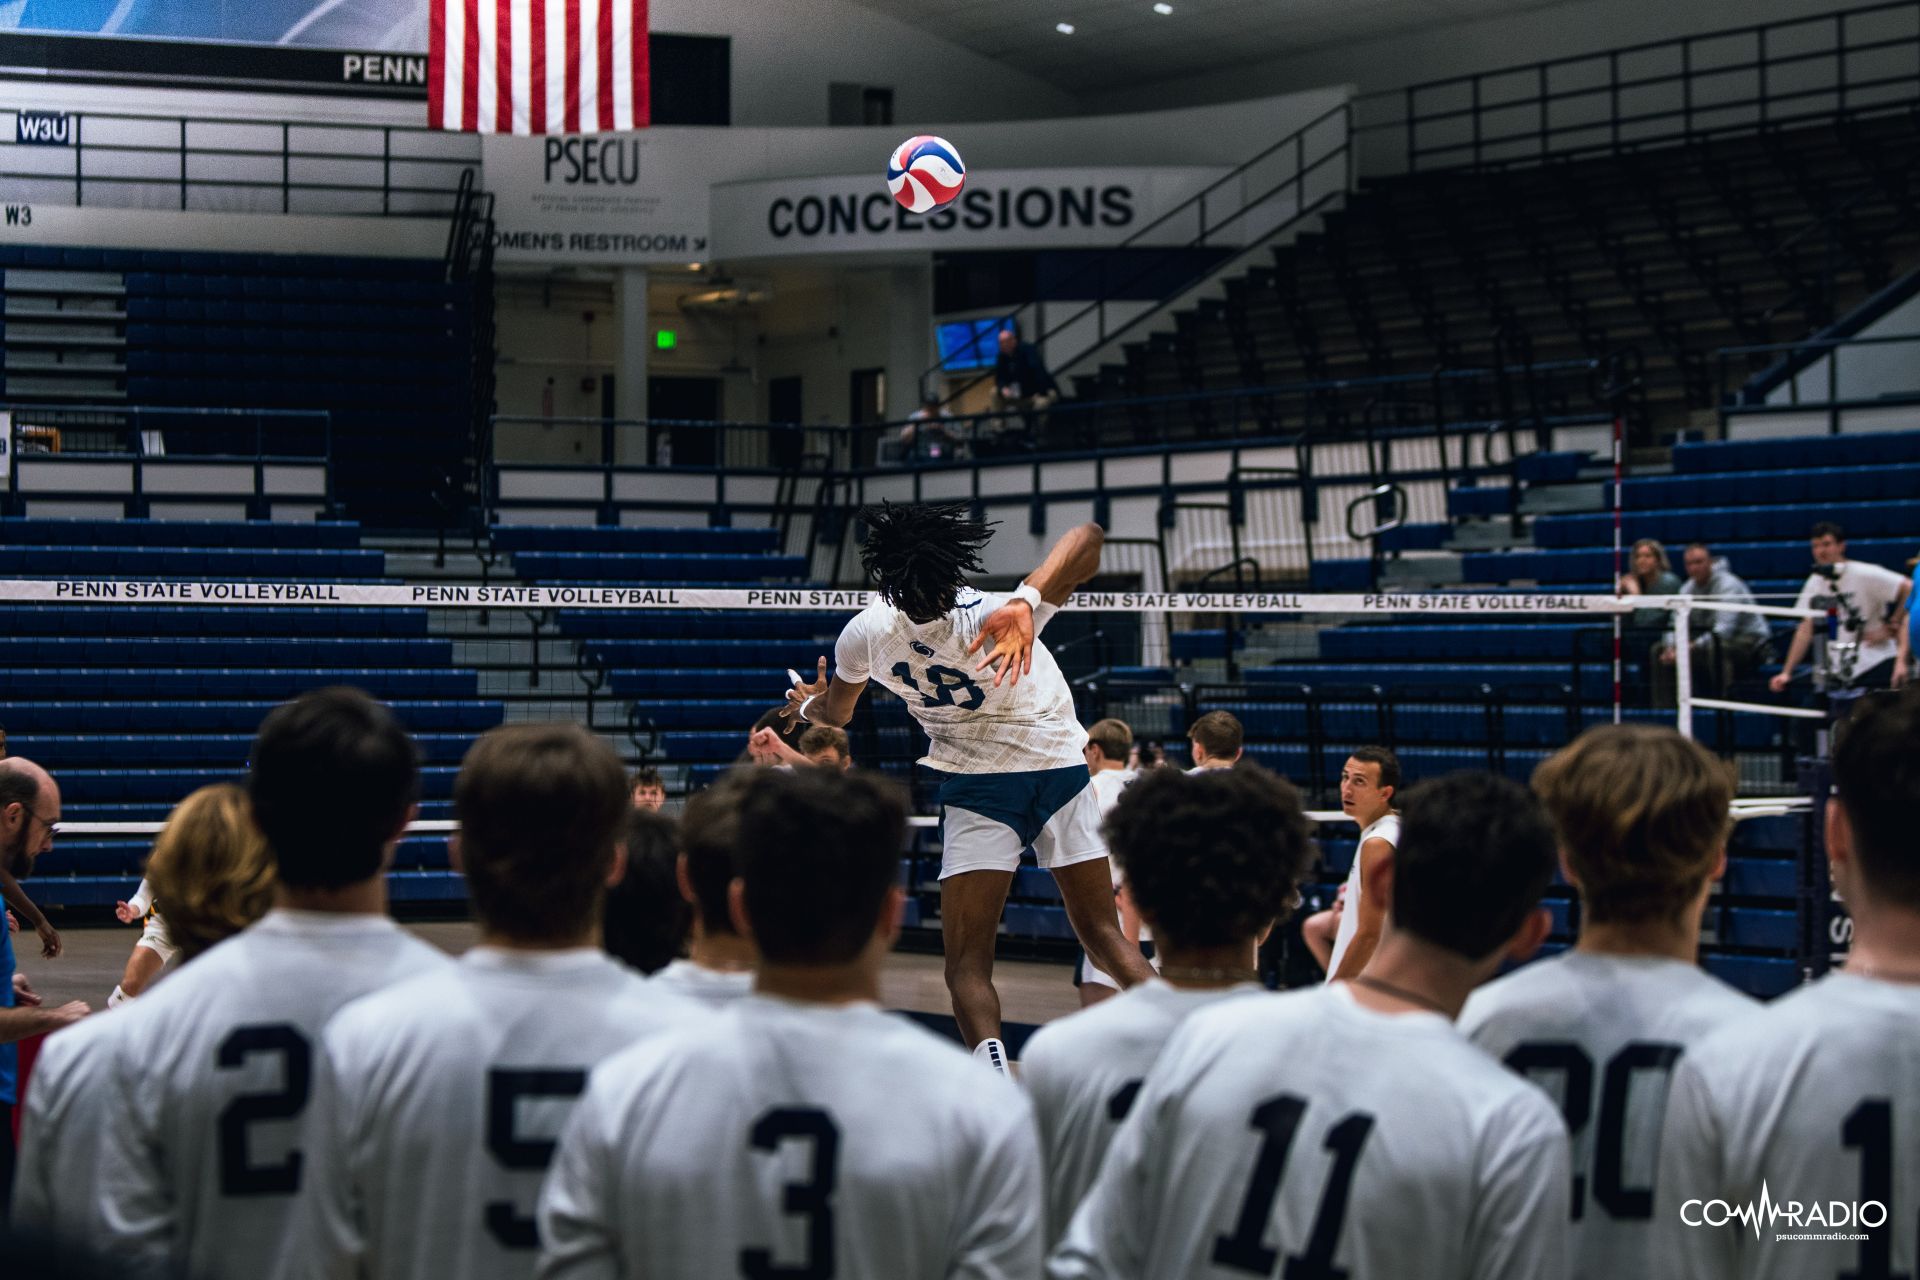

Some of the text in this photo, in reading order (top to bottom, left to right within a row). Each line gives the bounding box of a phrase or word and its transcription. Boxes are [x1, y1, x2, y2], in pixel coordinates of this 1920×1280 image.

[343, 55, 427, 84] PENN
[20, 117, 67, 141] W3U
[544, 136, 640, 184] PSECU
[5, 204, 32, 226] W3
[768, 185, 1134, 238] CONCESSIONS
[470, 231, 687, 253] OMEN'S RESTROOM
[56, 582, 340, 601] PENN STATE VOLLEYBALL
[412, 587, 680, 605] PENN STATE VOLLEYBALL
[747, 591, 868, 606] PENN STATE
[1065, 593, 1302, 609] PENN STATE VOLLEYBALL
[1363, 594, 1588, 611] PENN STATE VOLLEYBALL
[891, 662, 987, 711] 18
[215, 1022, 312, 1196] 2
[484, 1067, 588, 1250] 5
[740, 1106, 840, 1280] 3
[1211, 1093, 1376, 1280] 11
